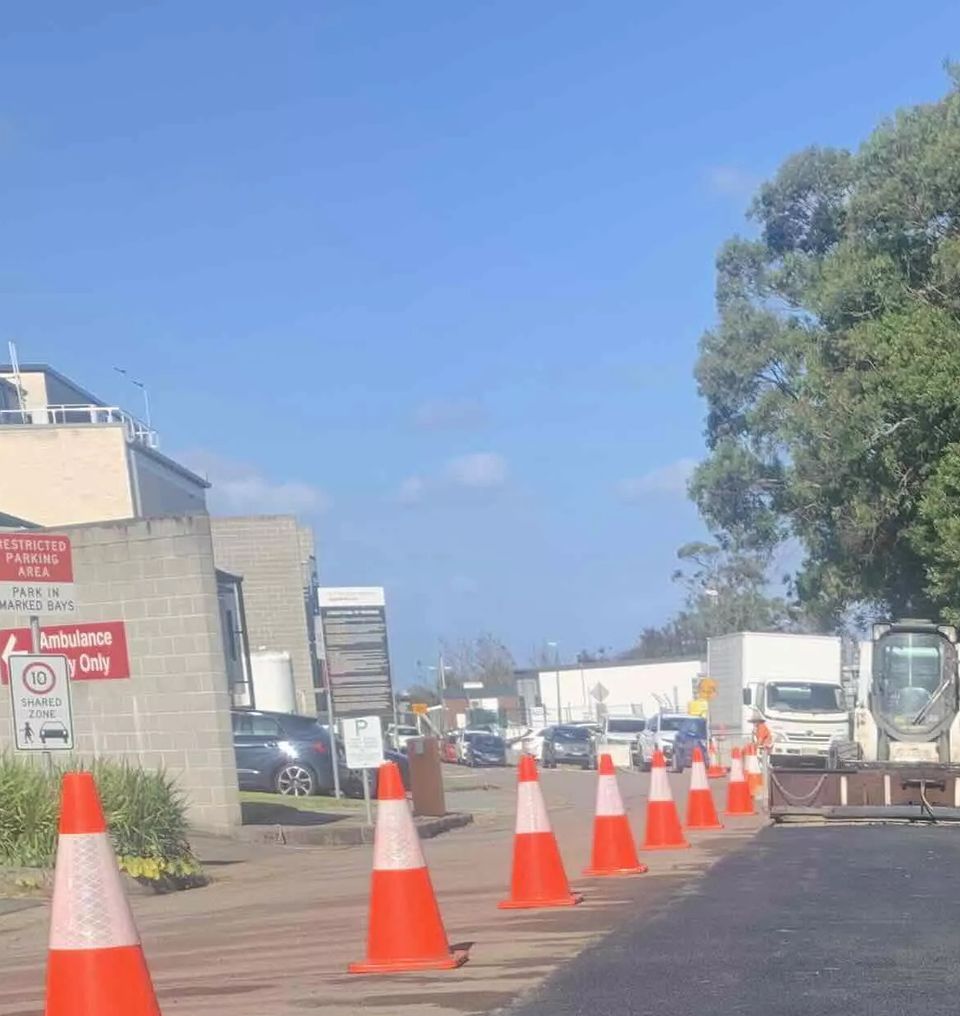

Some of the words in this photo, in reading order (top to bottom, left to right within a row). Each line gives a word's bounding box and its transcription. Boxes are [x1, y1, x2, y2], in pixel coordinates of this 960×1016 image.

[6, 552, 60, 565] PARKING
[18, 566, 50, 578] AREA
[12, 586, 42, 599] PARK
[48, 587, 60, 598] IN
[0, 600, 42, 611] MARKED
[47, 601, 75, 611] BAYS
[40, 629, 112, 649] Ambulance
[79, 652, 110, 676] Only
[31, 671, 47, 685] 10
[20, 697, 62, 708] SHARED
[28, 709, 56, 719] ZONE
[355, 719, 368, 737] P
